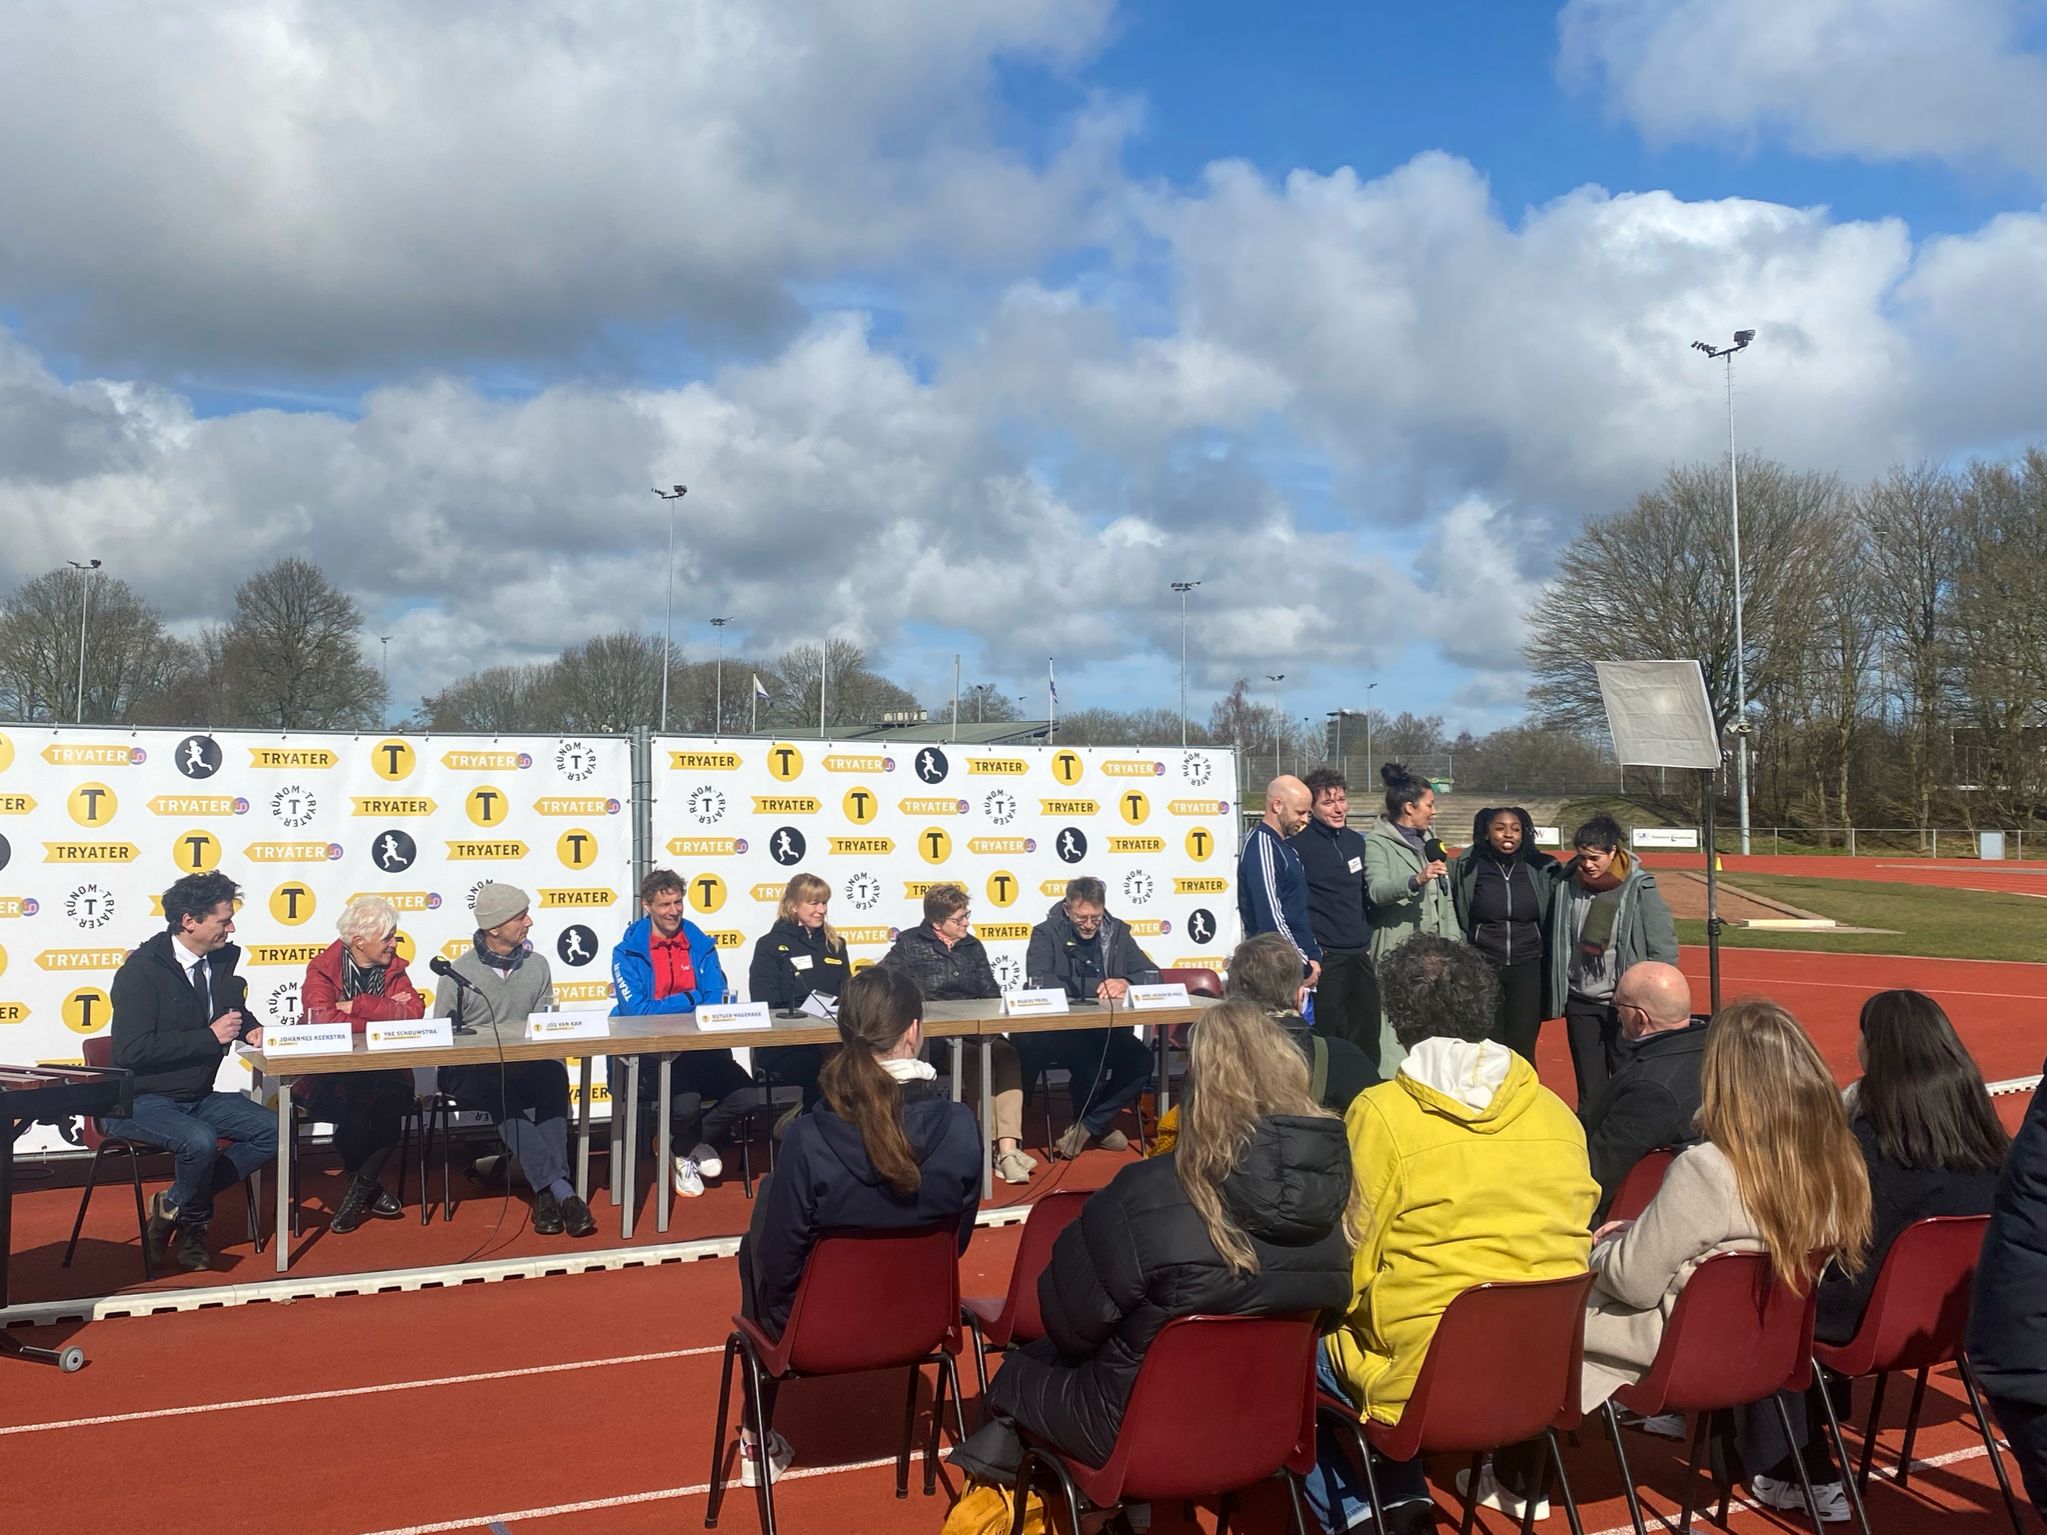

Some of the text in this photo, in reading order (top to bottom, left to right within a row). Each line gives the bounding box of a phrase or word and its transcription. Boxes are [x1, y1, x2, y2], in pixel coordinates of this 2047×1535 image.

[52, 749, 127, 762] TRYATER
[262, 753, 328, 765] TRYATER
[382, 745, 405, 775] T
[450, 755, 517, 767] TRYATER
[680, 755, 734, 767] TRYATER
[571, 755, 581, 770] T
[776, 749, 794, 776] T
[830, 759, 882, 770] TRYATER
[975, 762, 1022, 772] TRYATER
[1059, 756, 1076, 781] T
[1108, 763, 1153, 774] TRYATER
[1192, 764, 1200, 776] T
[80, 789, 105, 820] T
[157, 800, 229, 812] TRYATER
[288, 799, 300, 815] T
[363, 801, 427, 812] TRYATER
[476, 792, 498, 821] T
[542, 800, 605, 811] TRYATER
[702, 799, 712, 813] T
[761, 800, 814, 811] TRYATER
[851, 792, 869, 819] T
[905, 801, 957, 812] TRYATER
[996, 801, 1004, 814] T
[1048, 803, 1094, 813] TRYATER
[1126, 795, 1143, 820] T
[1173, 803, 1219, 812] TRYATER
[457, 845, 520, 856] TRYATER
[567, 835, 588, 864] T
[675, 842, 733, 852] TRYATER
[837, 840, 888, 851] TRYATER
[926, 833, 943, 858] T
[974, 841, 1023, 851] TRYATER
[1116, 840, 1160, 850] TRYATER
[1192, 832, 1207, 857] T
[56, 846, 129, 859] TRYATER
[185, 837, 210, 868] T
[255, 847, 325, 859] TRYATER
[859, 884, 868, 898] T
[994, 876, 1011, 902] T
[1134, 881, 1142, 893] T
[1181, 881, 1223, 891] TRYATER
[549, 892, 609, 904] TRYATER
[697, 879, 718, 907] T
[84, 899, 97, 915] T
[281, 888, 305, 919] T
[387, 894, 426, 907] ATER
[981, 926, 1028, 938] TRYATER
[45, 953, 124, 967] TRYATER
[1000, 967, 1009, 981] T
[74, 994, 100, 1027] T
[286, 996, 297, 1013] T
